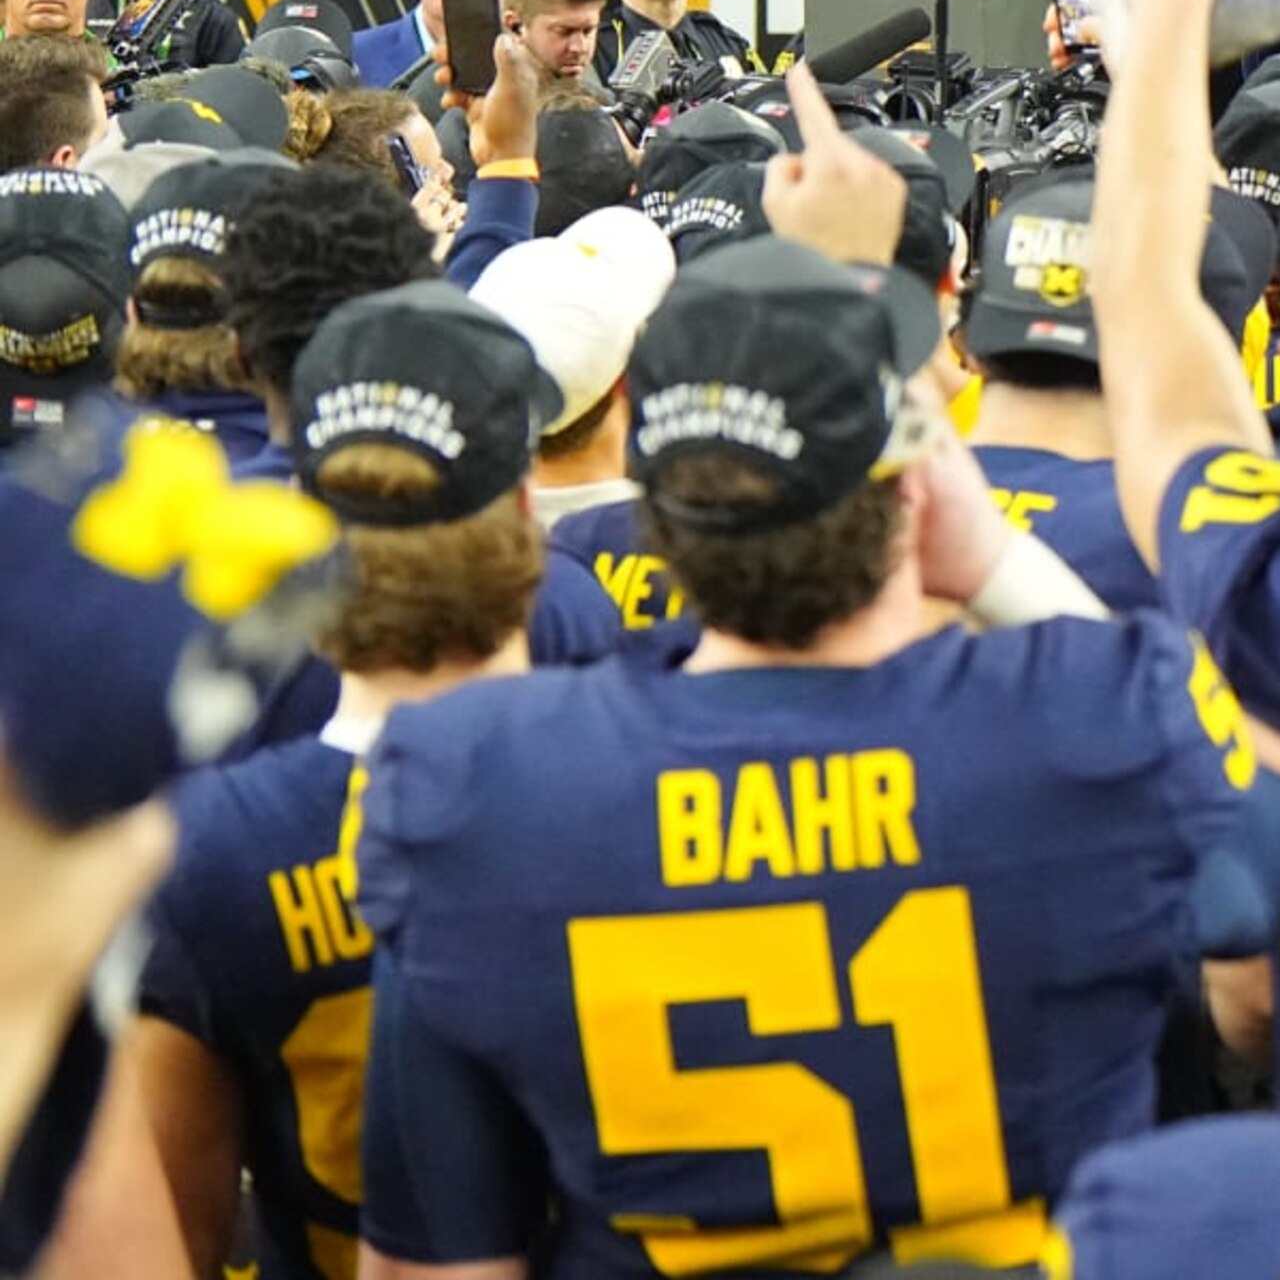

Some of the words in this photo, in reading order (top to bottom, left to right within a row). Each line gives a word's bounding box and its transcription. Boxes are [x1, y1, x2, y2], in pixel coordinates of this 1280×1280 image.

[671, 197, 744, 224] NATIONAL
[657, 748, 921, 889] BAHR
[566, 884, 1048, 1276] 51
